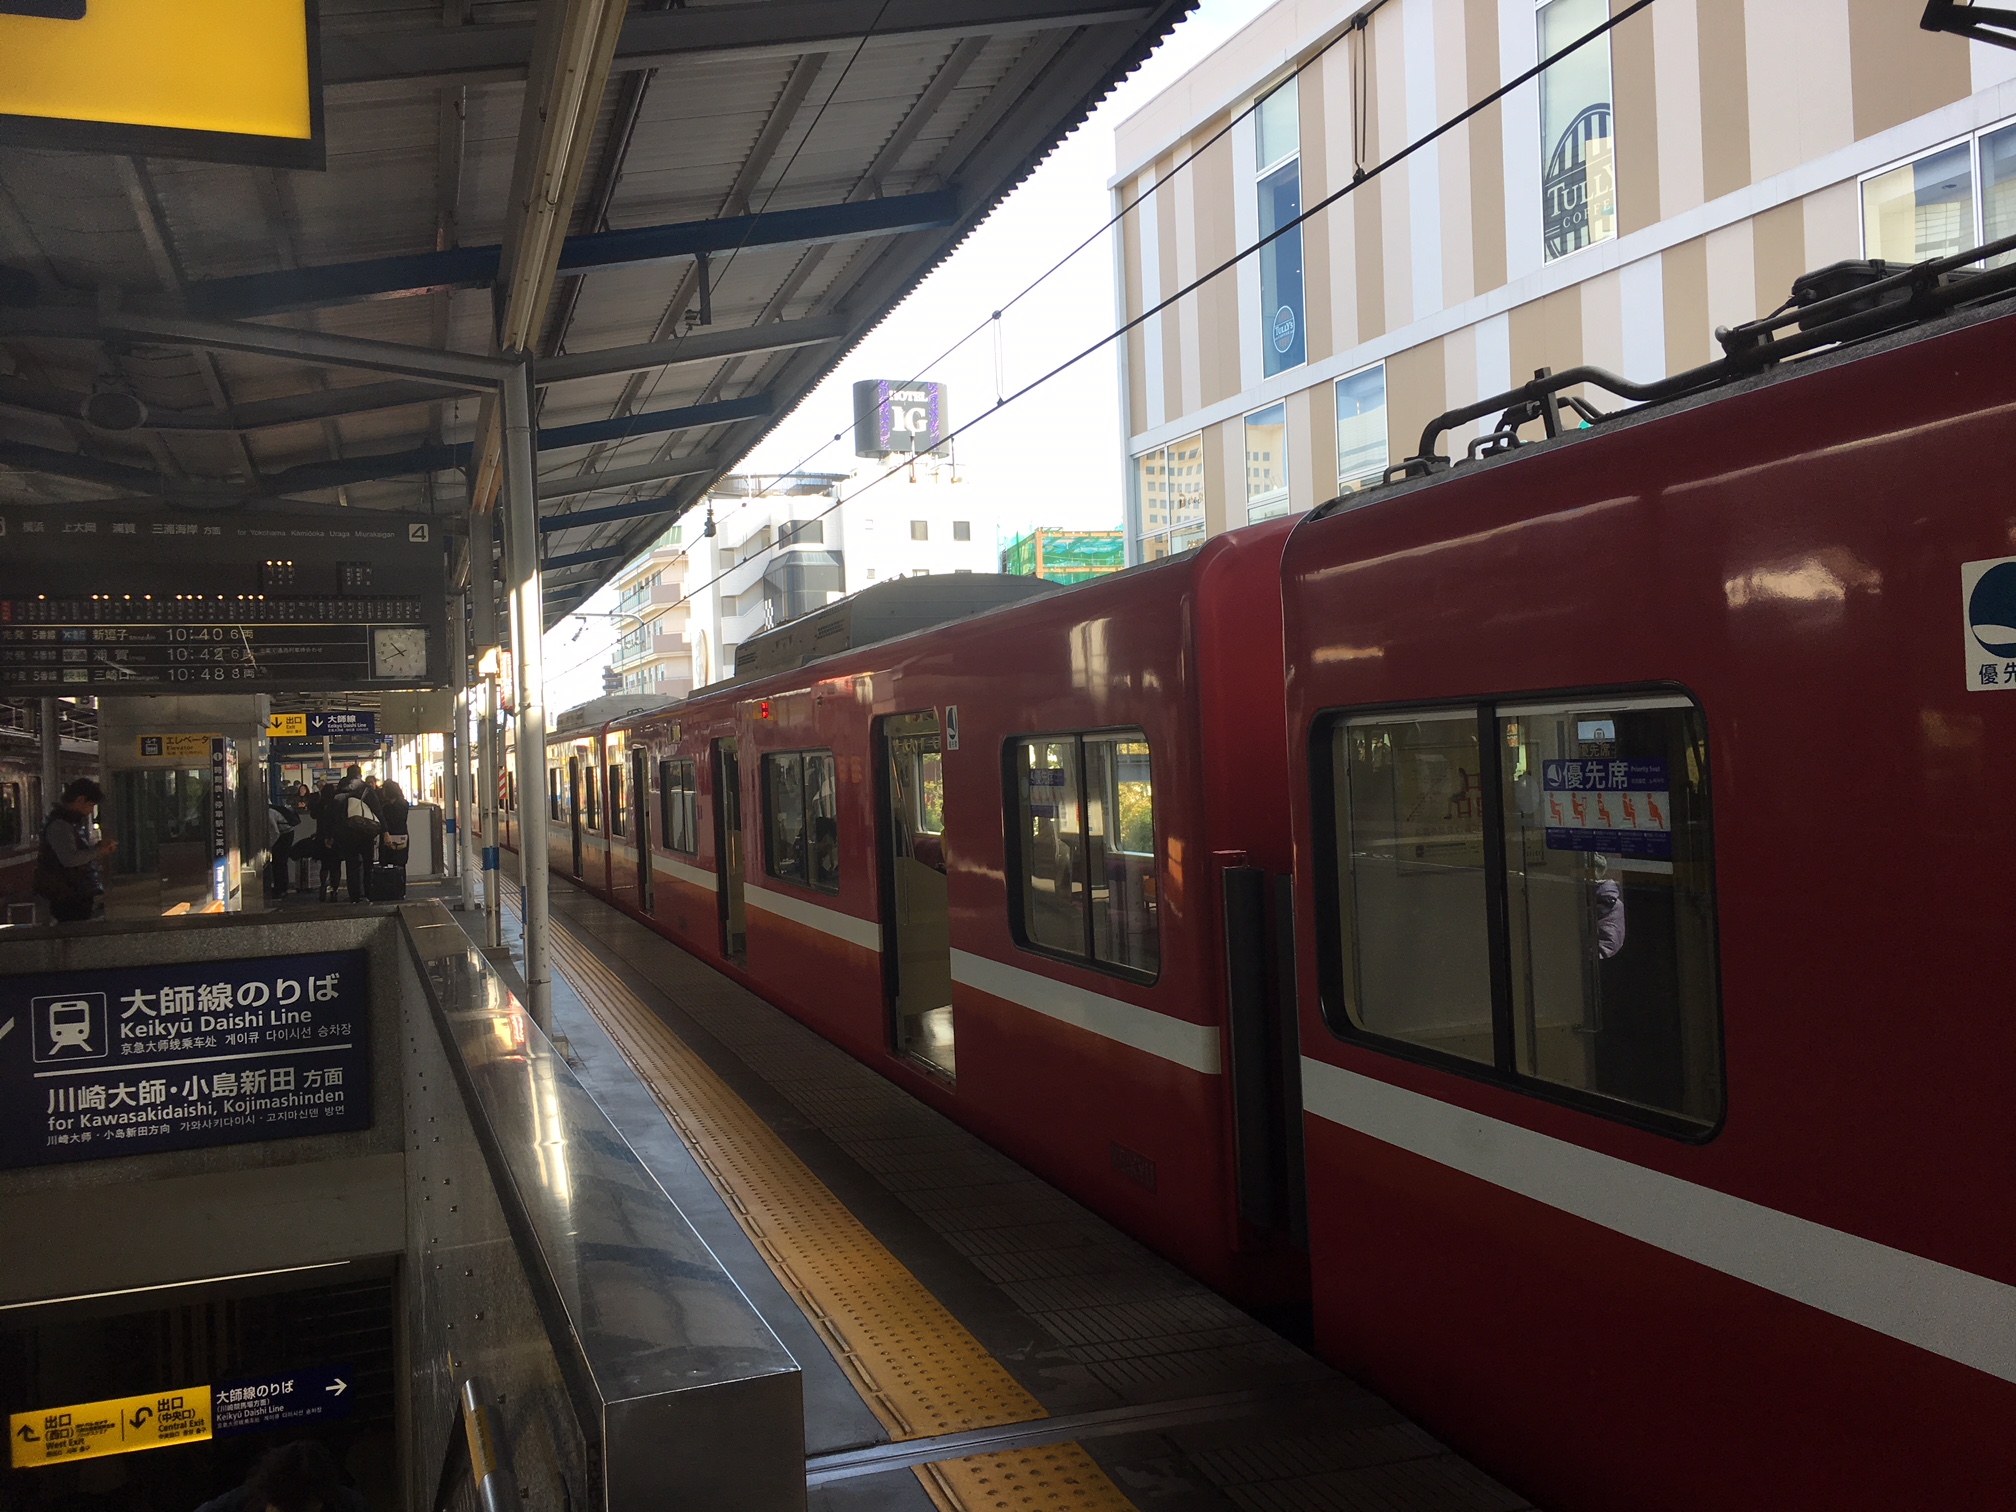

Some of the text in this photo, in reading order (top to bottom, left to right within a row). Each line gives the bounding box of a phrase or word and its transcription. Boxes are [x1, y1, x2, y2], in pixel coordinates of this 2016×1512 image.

[889, 389, 929, 403] HOTEL
[892, 405, 928, 433] IG
[22, 521, 221, 535] 横浜 上大岡 浦賀 三浦海岸 方面
[250, 529, 286, 537] Yokohama
[329, 531, 350, 539] Uraga
[354, 531, 395, 540] Miurakaigan
[92, 628, 128, 641] 新逗子
[166, 628, 223, 641] 10:40
[167, 647, 223, 661] 10:42
[94, 669, 130, 681] 三崎口
[168, 667, 225, 681] 10:48
[286, 716, 302, 725] 出口
[327, 715, 356, 724] 大師線
[1563, 760, 1628, 789] 優先席
[120, 972, 340, 1019] 大師線のりば
[120, 1006, 312, 1041] Keikyū Daishi Line
[225, 1022, 352, 1046] 게이큐 다이시선 승차장
[303, 1066, 344, 1090] 方面
[48, 1088, 345, 1132] for Kawasakidaishi, Kojimashinden
[216, 1379, 295, 1405] 大師線のりば
[158, 1396, 183, 1413] 出口
[158, 1408, 196, 1424] (中央口)
[217, 1404, 284, 1422] Keikyū Daishi Line
[45, 1413, 71, 1430] 出口
[158, 1418, 205, 1432] Central Exit
[46, 1437, 85, 1451] West Exit
